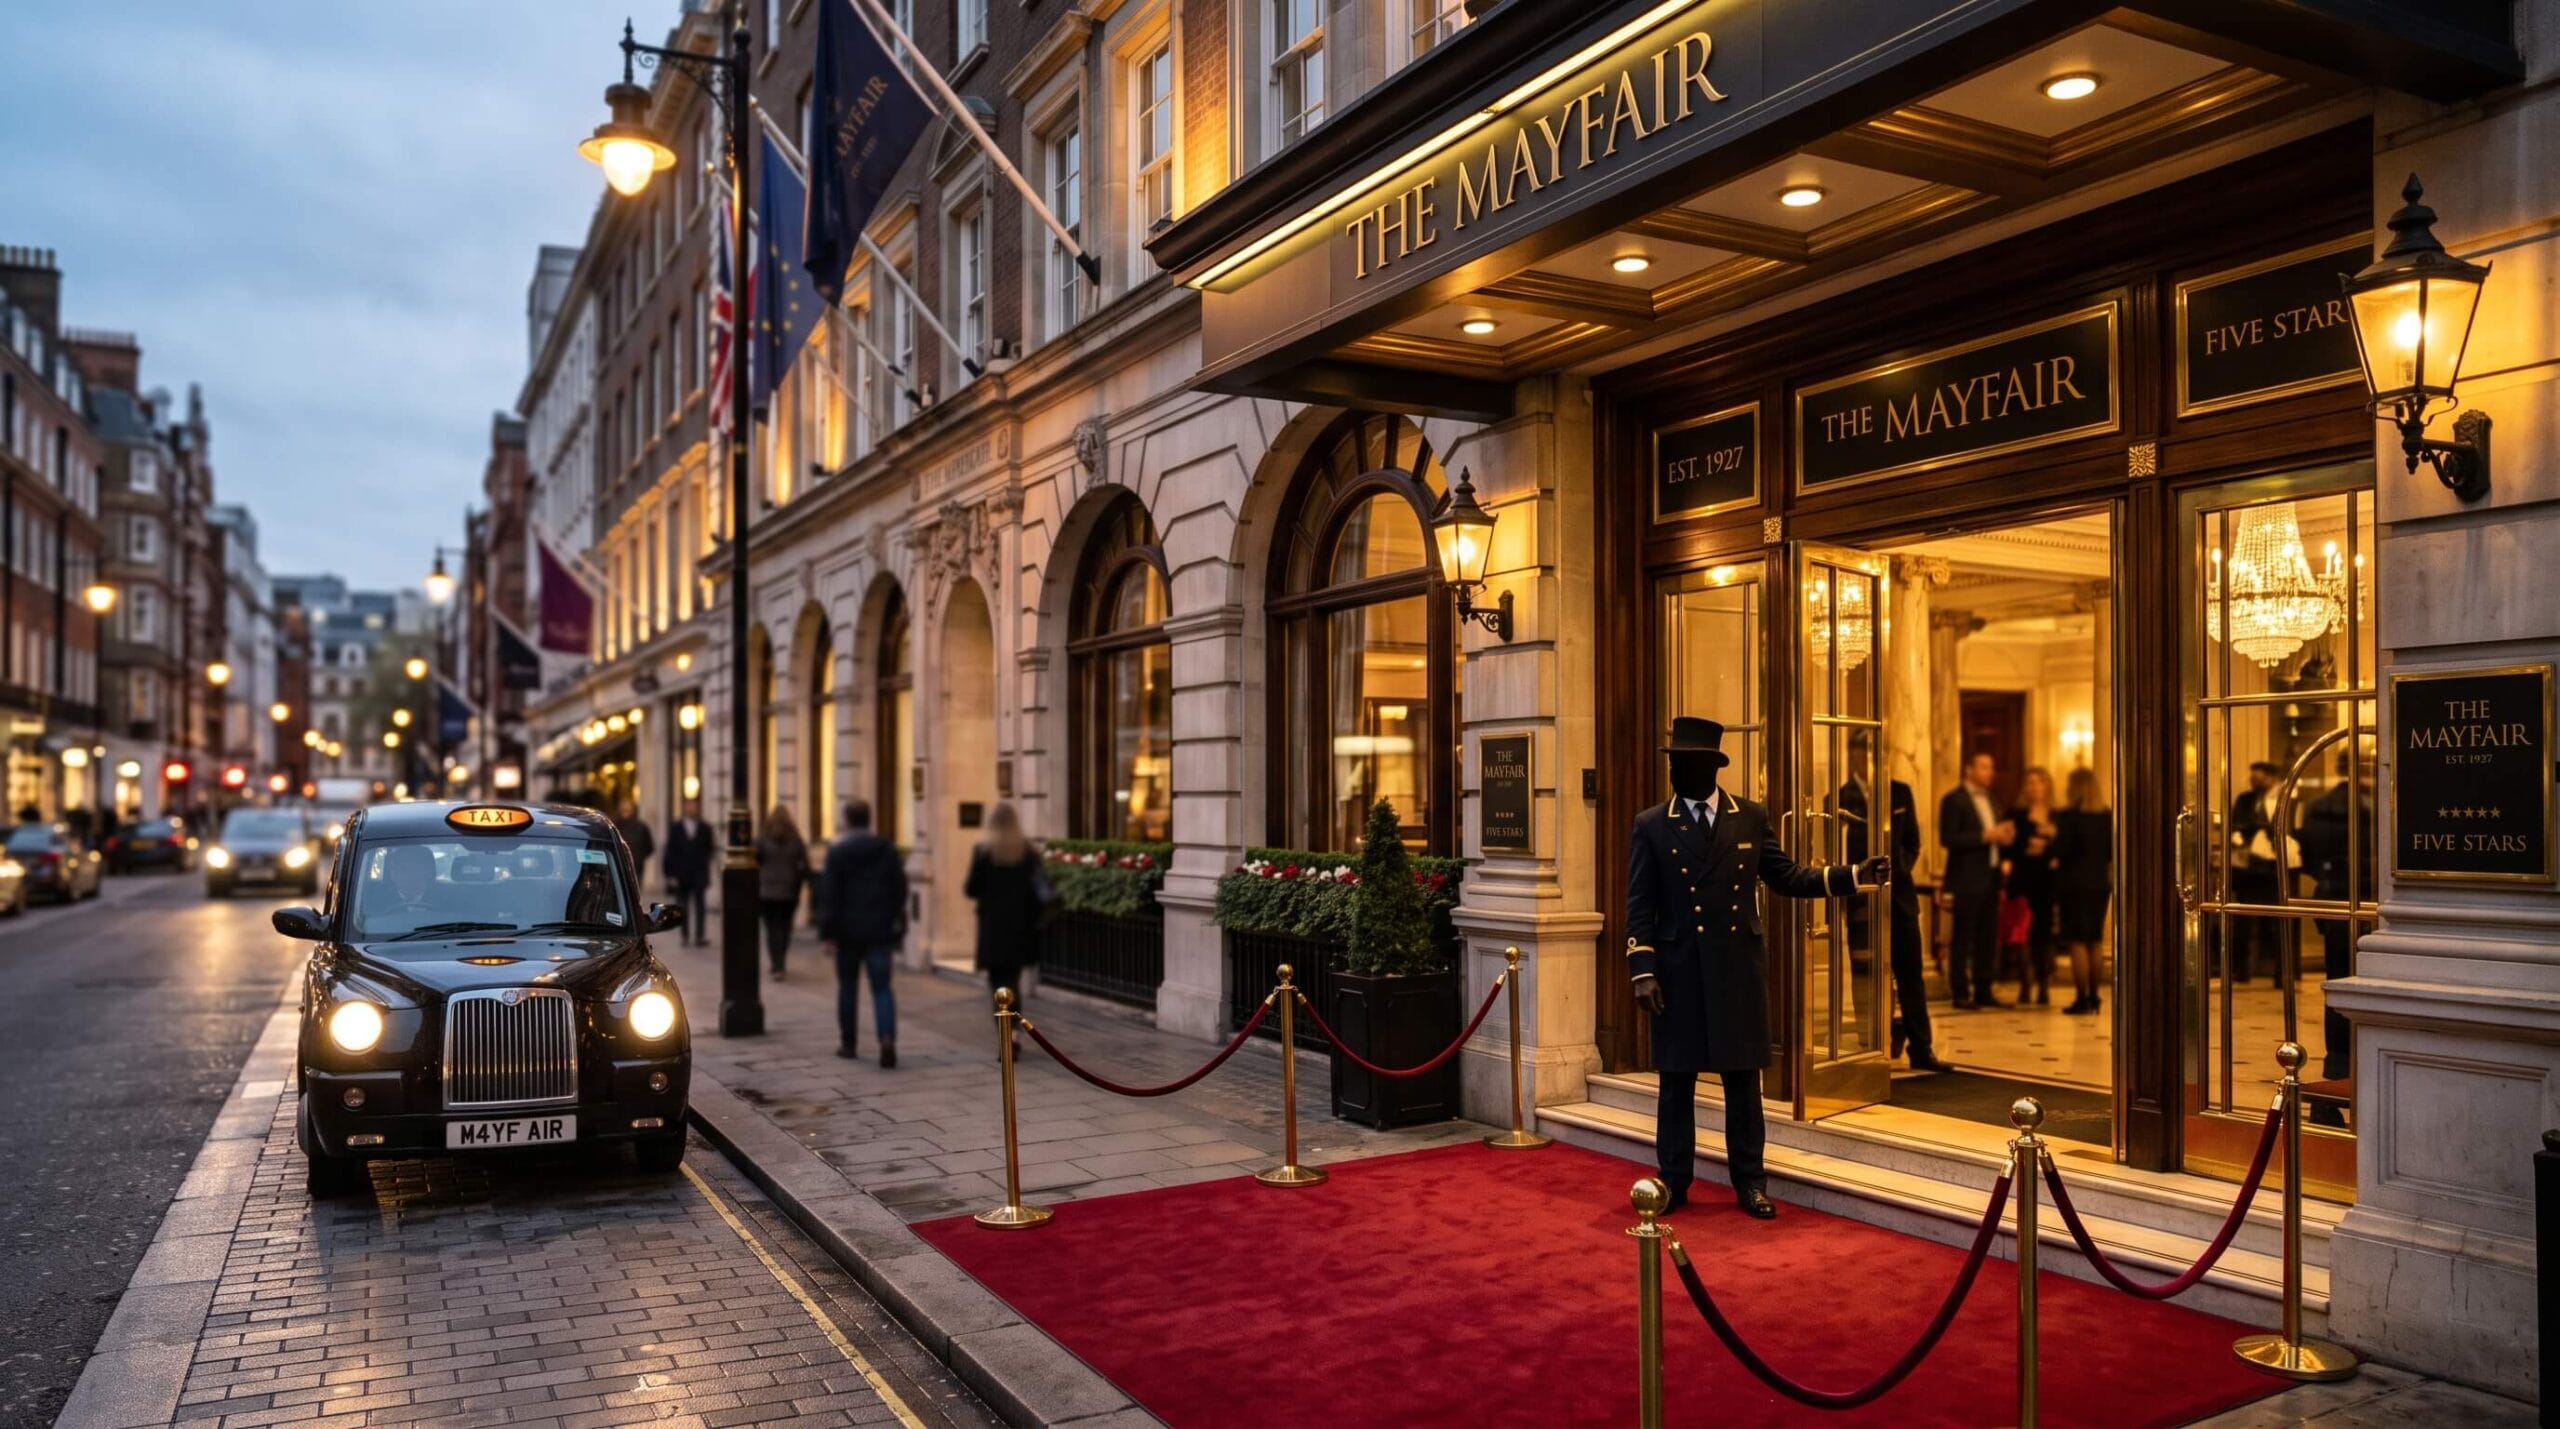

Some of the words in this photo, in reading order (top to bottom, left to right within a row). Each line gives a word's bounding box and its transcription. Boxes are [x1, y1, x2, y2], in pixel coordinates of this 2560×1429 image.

[1345, 176, 1437, 280] THE
[1453, 31, 1728, 231] MAYFAIR
[2205, 318, 2263, 355] FIVE
[2273, 299, 2349, 339] STAR
[1821, 405, 1873, 443] THE
[1883, 356, 2086, 443] MAYFAIR
[1668, 456, 1700, 484] EST.
[1706, 446, 1744, 476] 1927
[2444, 699, 2490, 720] THE
[2409, 723, 2533, 749] MAYFAIR
[1495, 750, 1513, 763] THE
[2445, 755, 2465, 765] EST.
[2469, 754, 2493, 764] 1927
[1484, 764, 1526, 779] MAYFAIR
[468, 811, 513, 823] TAXI
[1486, 827, 1502, 838] FIVE
[1502, 827, 1524, 838] STARS
[2413, 833, 2456, 851] FIVE
[2463, 833, 2528, 852] STARS
[460, 1120, 520, 1144] M4YF
[528, 1119, 564, 1141] AIR
